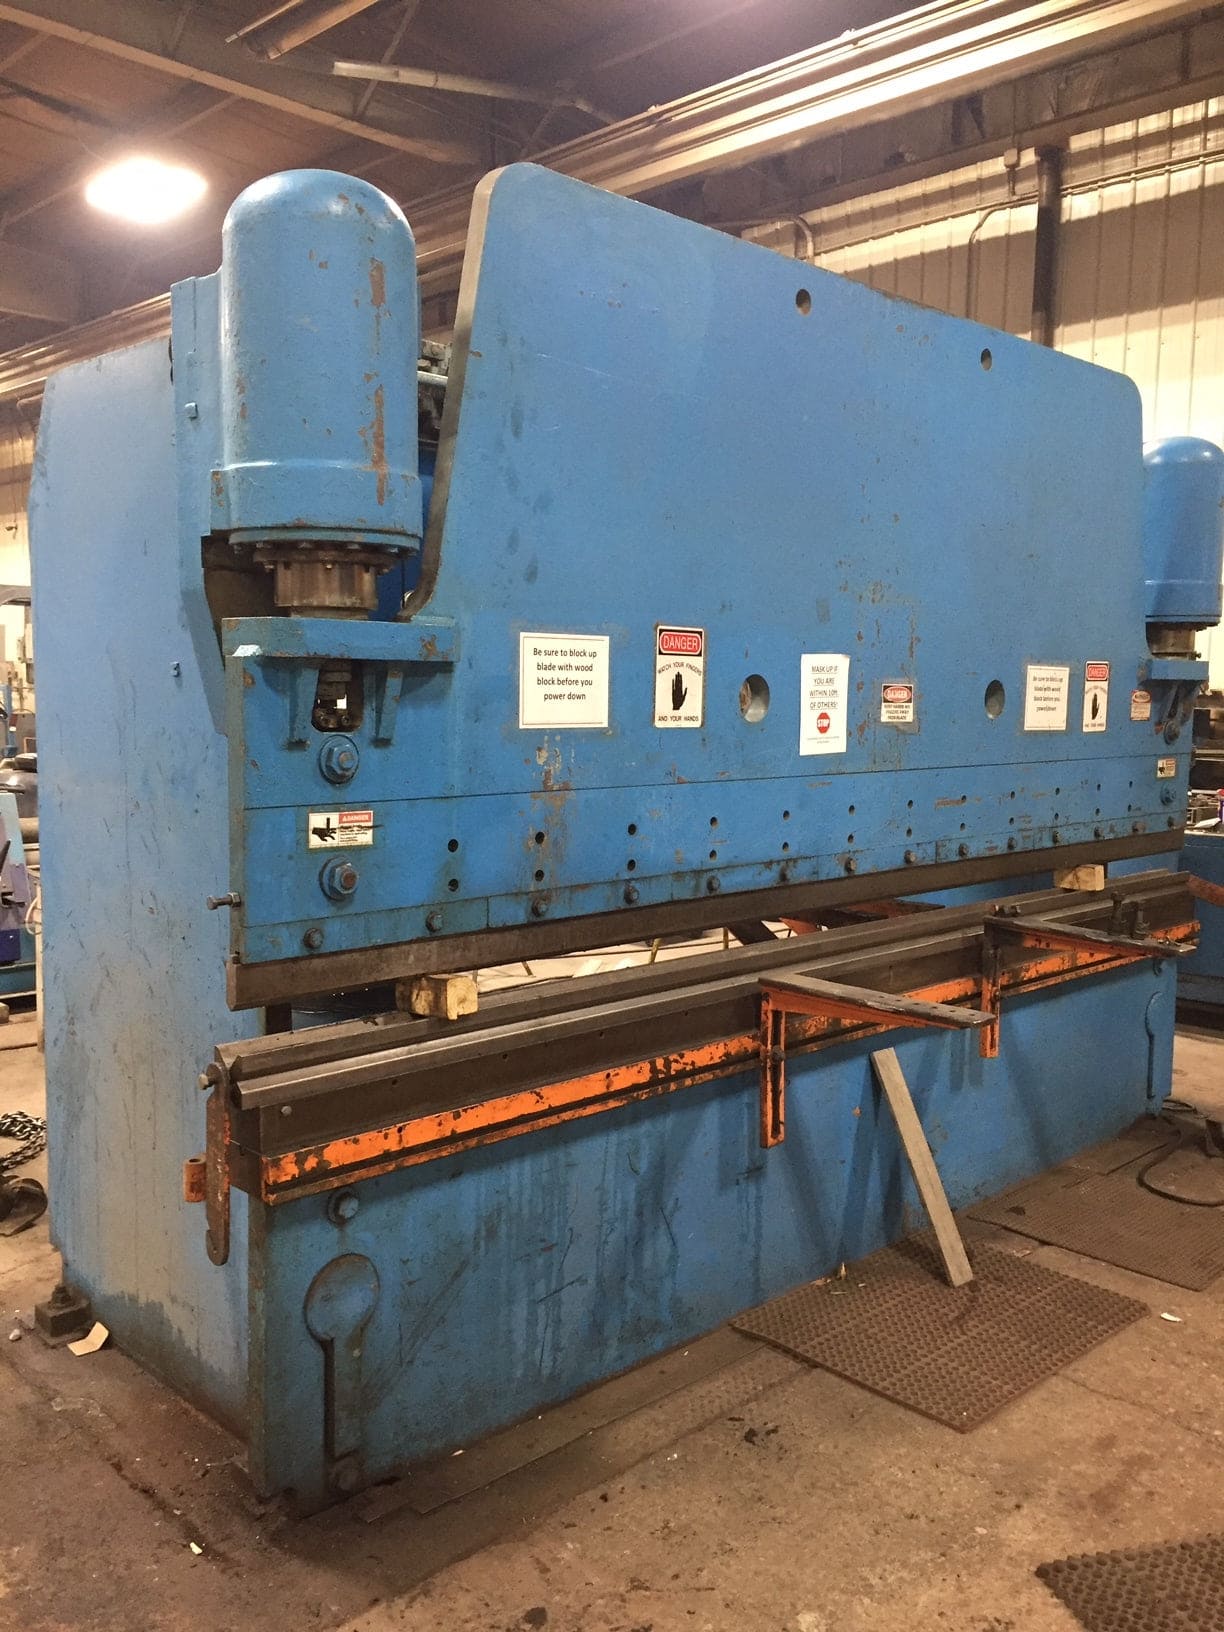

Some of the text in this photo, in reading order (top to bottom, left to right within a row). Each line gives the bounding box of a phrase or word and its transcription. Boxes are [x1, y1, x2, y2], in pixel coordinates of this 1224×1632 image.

[663, 635, 698, 650] DANGER
[533, 648, 542, 656] Be
[569, 648, 587, 657] block
[588, 651, 597, 659] up
[537, 662, 593, 672] blade with wood
[686, 663, 702, 676] FINGERS
[1090, 668, 1106, 677] DANGER
[537, 677, 556, 685] block
[557, 677, 579, 686] before
[544, 692, 586, 702] power down
[887, 690, 907, 699] DANGER
